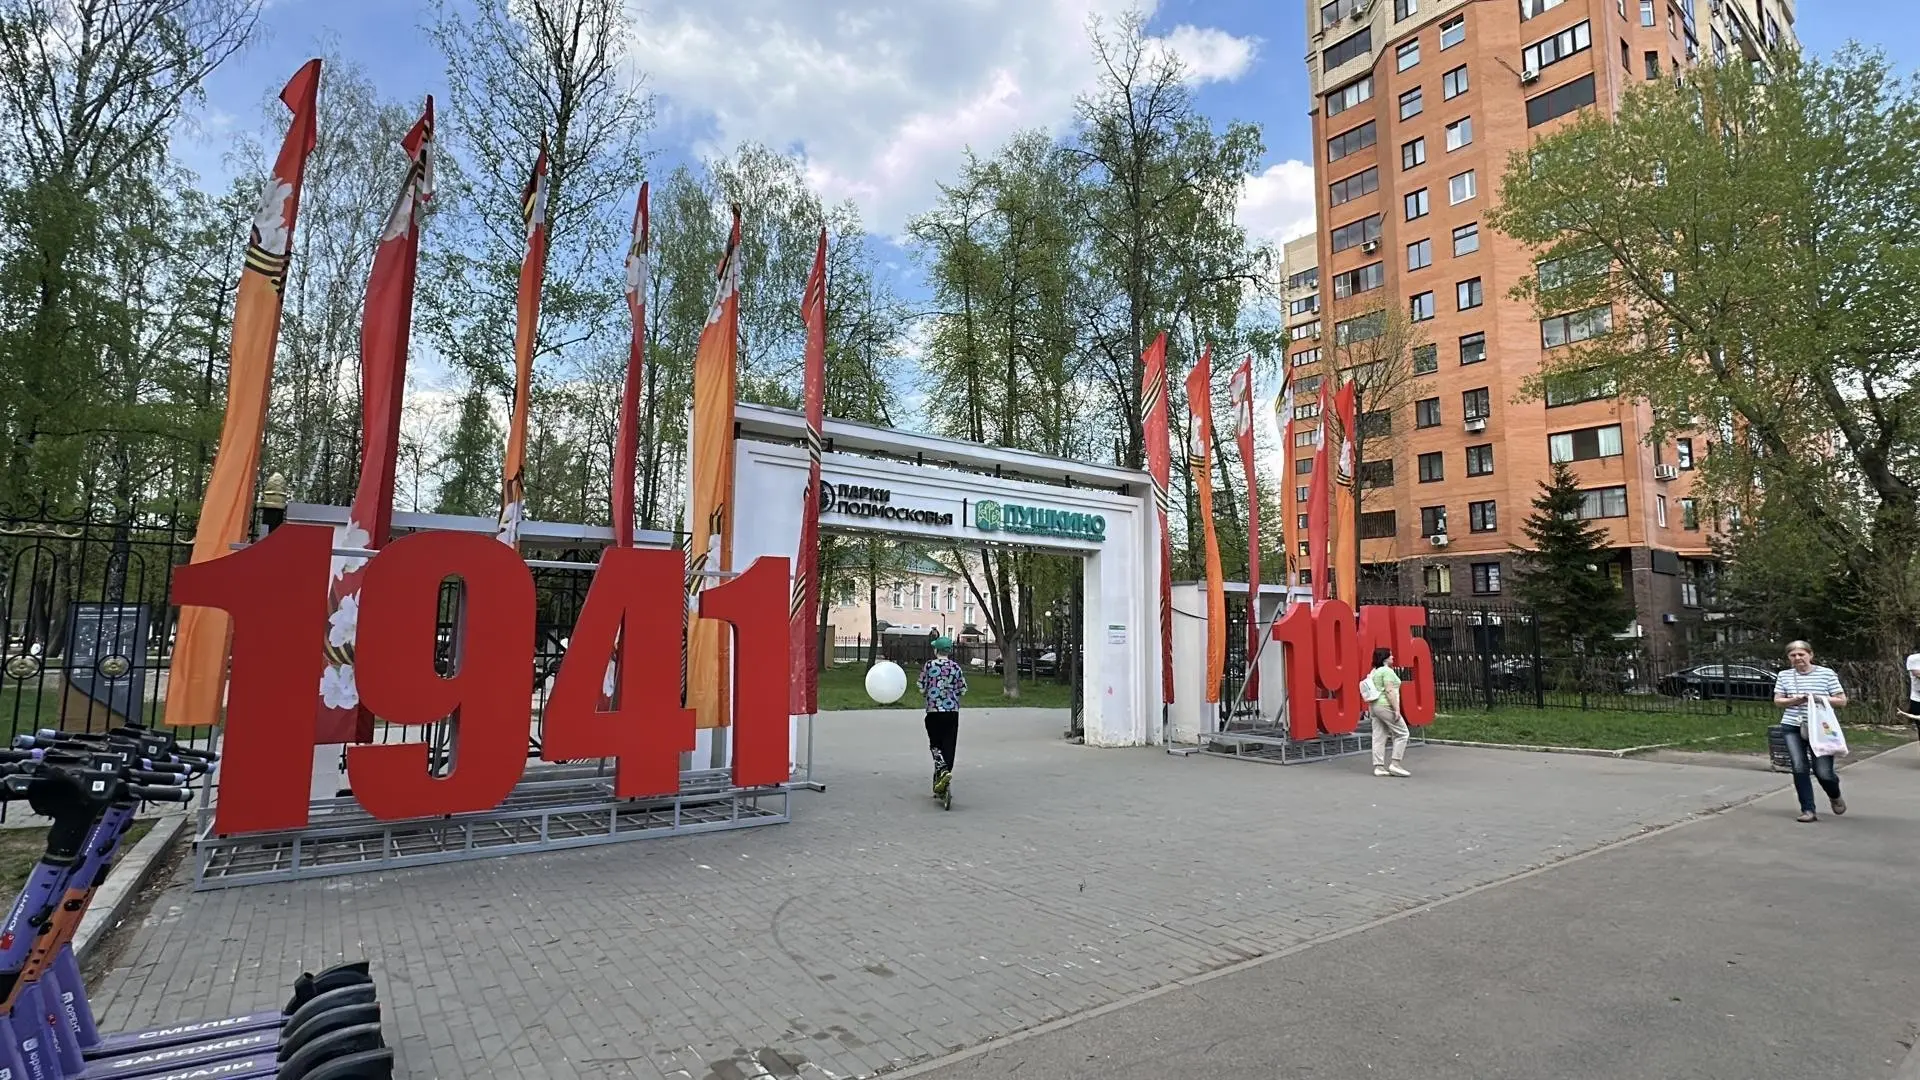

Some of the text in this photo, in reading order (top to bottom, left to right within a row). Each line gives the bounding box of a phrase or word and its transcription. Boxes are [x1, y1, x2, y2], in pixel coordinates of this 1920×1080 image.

[838, 483, 891, 502] ПАРКИ
[837, 501, 953, 525] ПОДМОСКОВЬЯ
[1003, 504, 1105, 534] ПУШКИНО
[172, 524, 791, 834] 1941
[9, 894, 29, 931] ЮРЕНТ
[65, 1003, 81, 1032] ЮРЕНТ
[138, 1015, 252, 1039] СМЕЛЕЕ
[112, 1036, 261, 1068] ЗАРЯЖЕН
